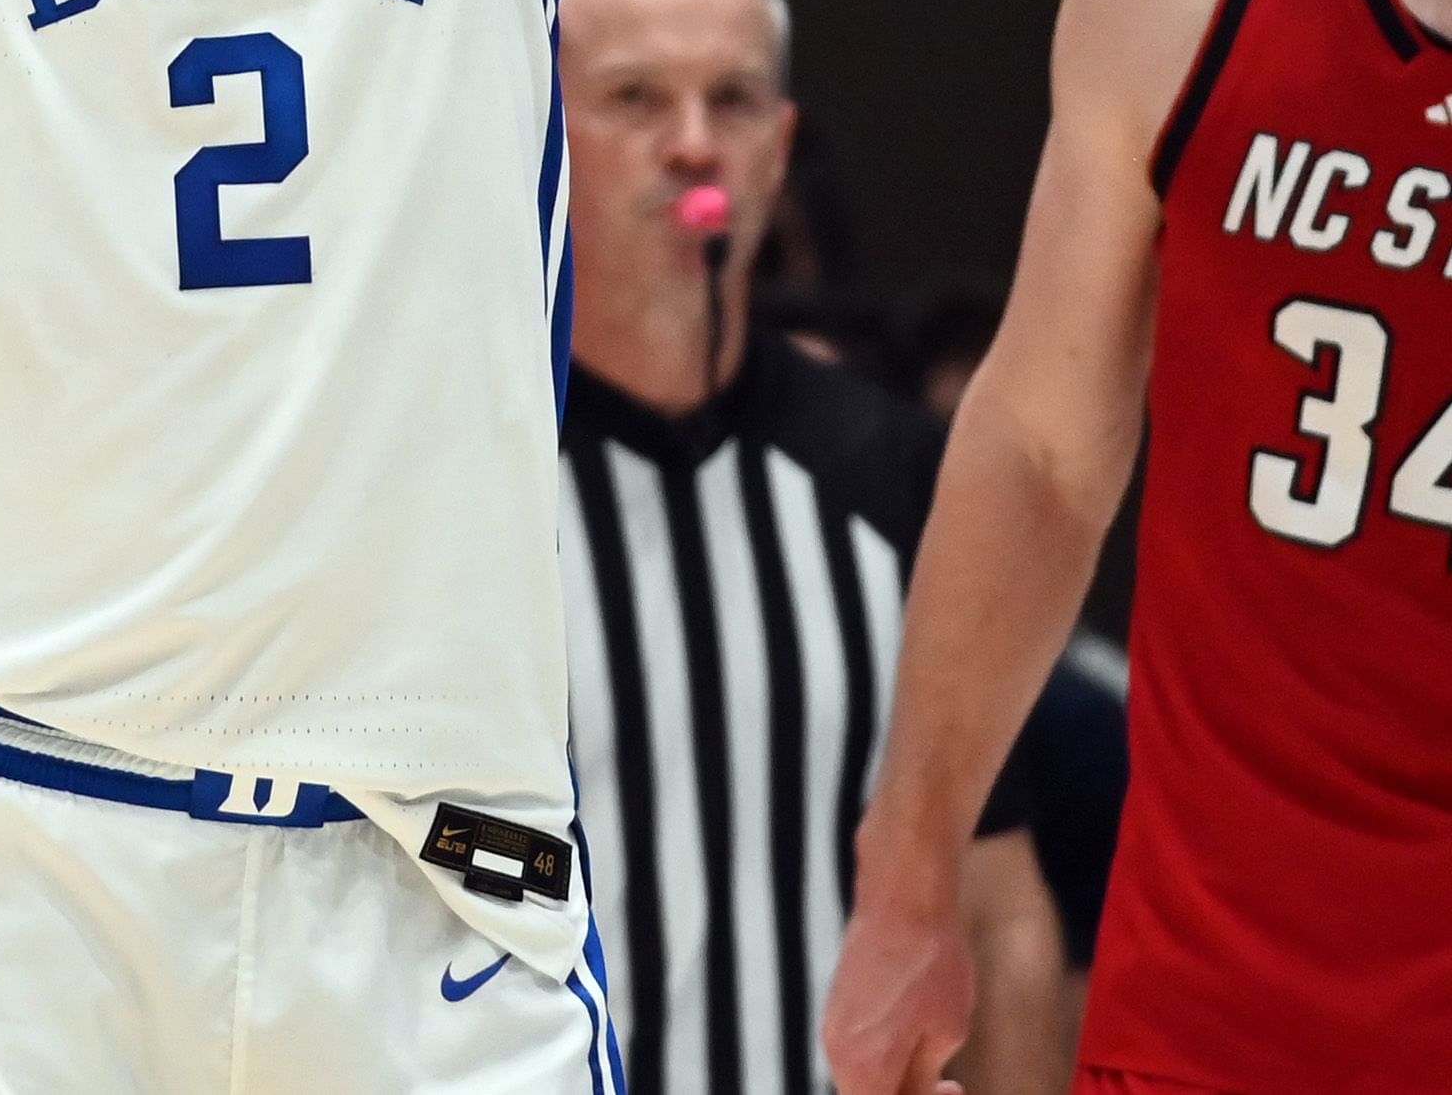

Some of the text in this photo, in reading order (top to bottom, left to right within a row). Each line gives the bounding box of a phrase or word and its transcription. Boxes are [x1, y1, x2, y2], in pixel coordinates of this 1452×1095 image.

[167, 32, 312, 290] 2
[1222, 132, 1452, 279] NC S
[533, 851, 555, 877] 48
